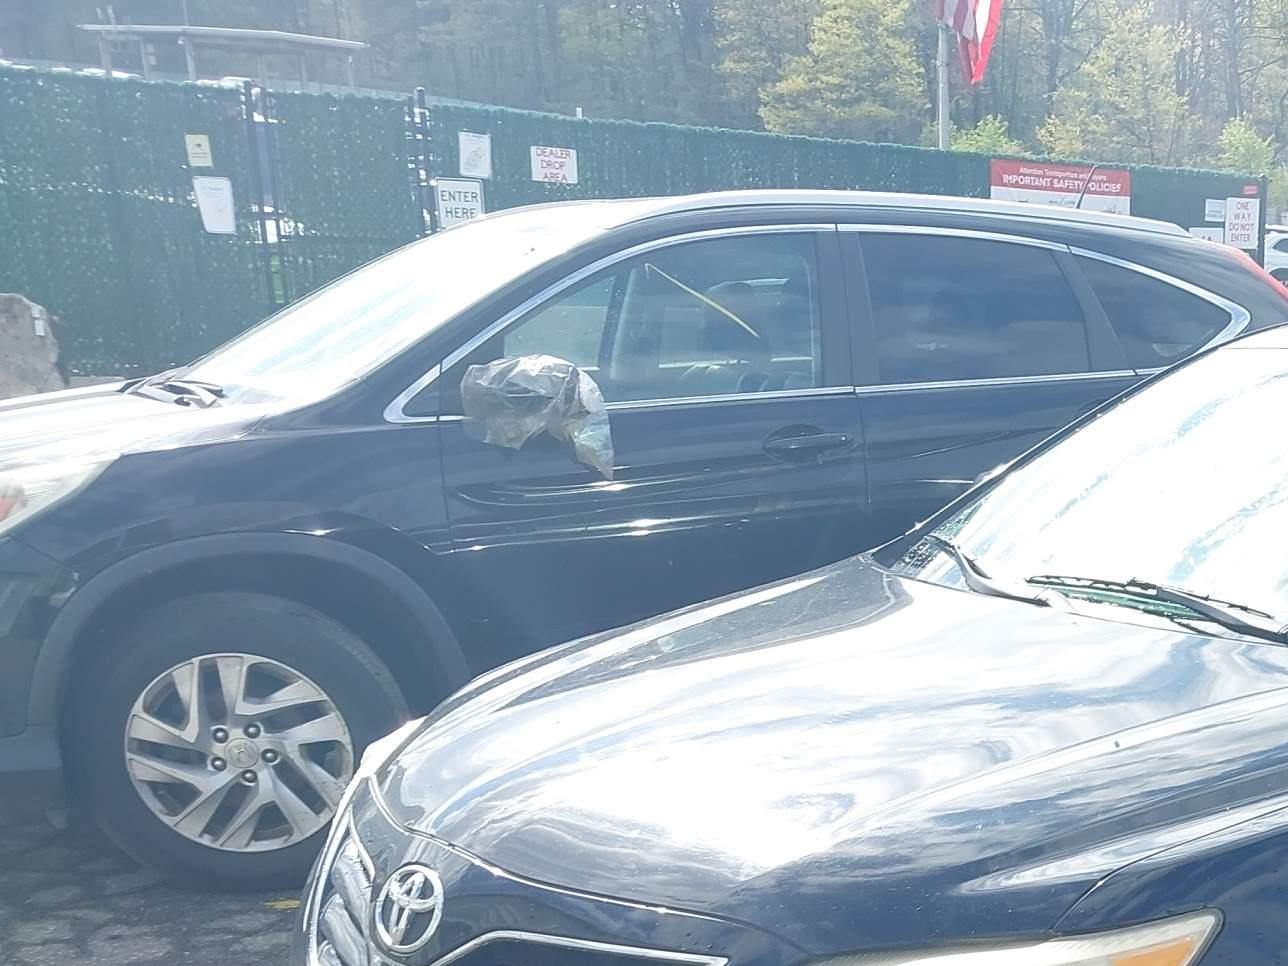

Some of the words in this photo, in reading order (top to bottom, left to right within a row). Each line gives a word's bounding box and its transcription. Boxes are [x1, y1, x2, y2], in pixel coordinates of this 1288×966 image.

[536, 147, 571, 159] DEALER
[541, 160, 566, 170] DROP
[542, 172, 568, 182] AREA
[1002, 173, 1051, 187] IMPORTANT
[1052, 178, 1083, 190] SAFETY
[440, 189, 479, 203] ENTER
[1235, 201, 1250, 210] ONE
[444, 206, 477, 219] HERE
[1234, 213, 1252, 221] WAY
[1229, 222, 1240, 232] DO
[1241, 223, 1255, 232] NOT
[1231, 233, 1251, 242] ENTER
